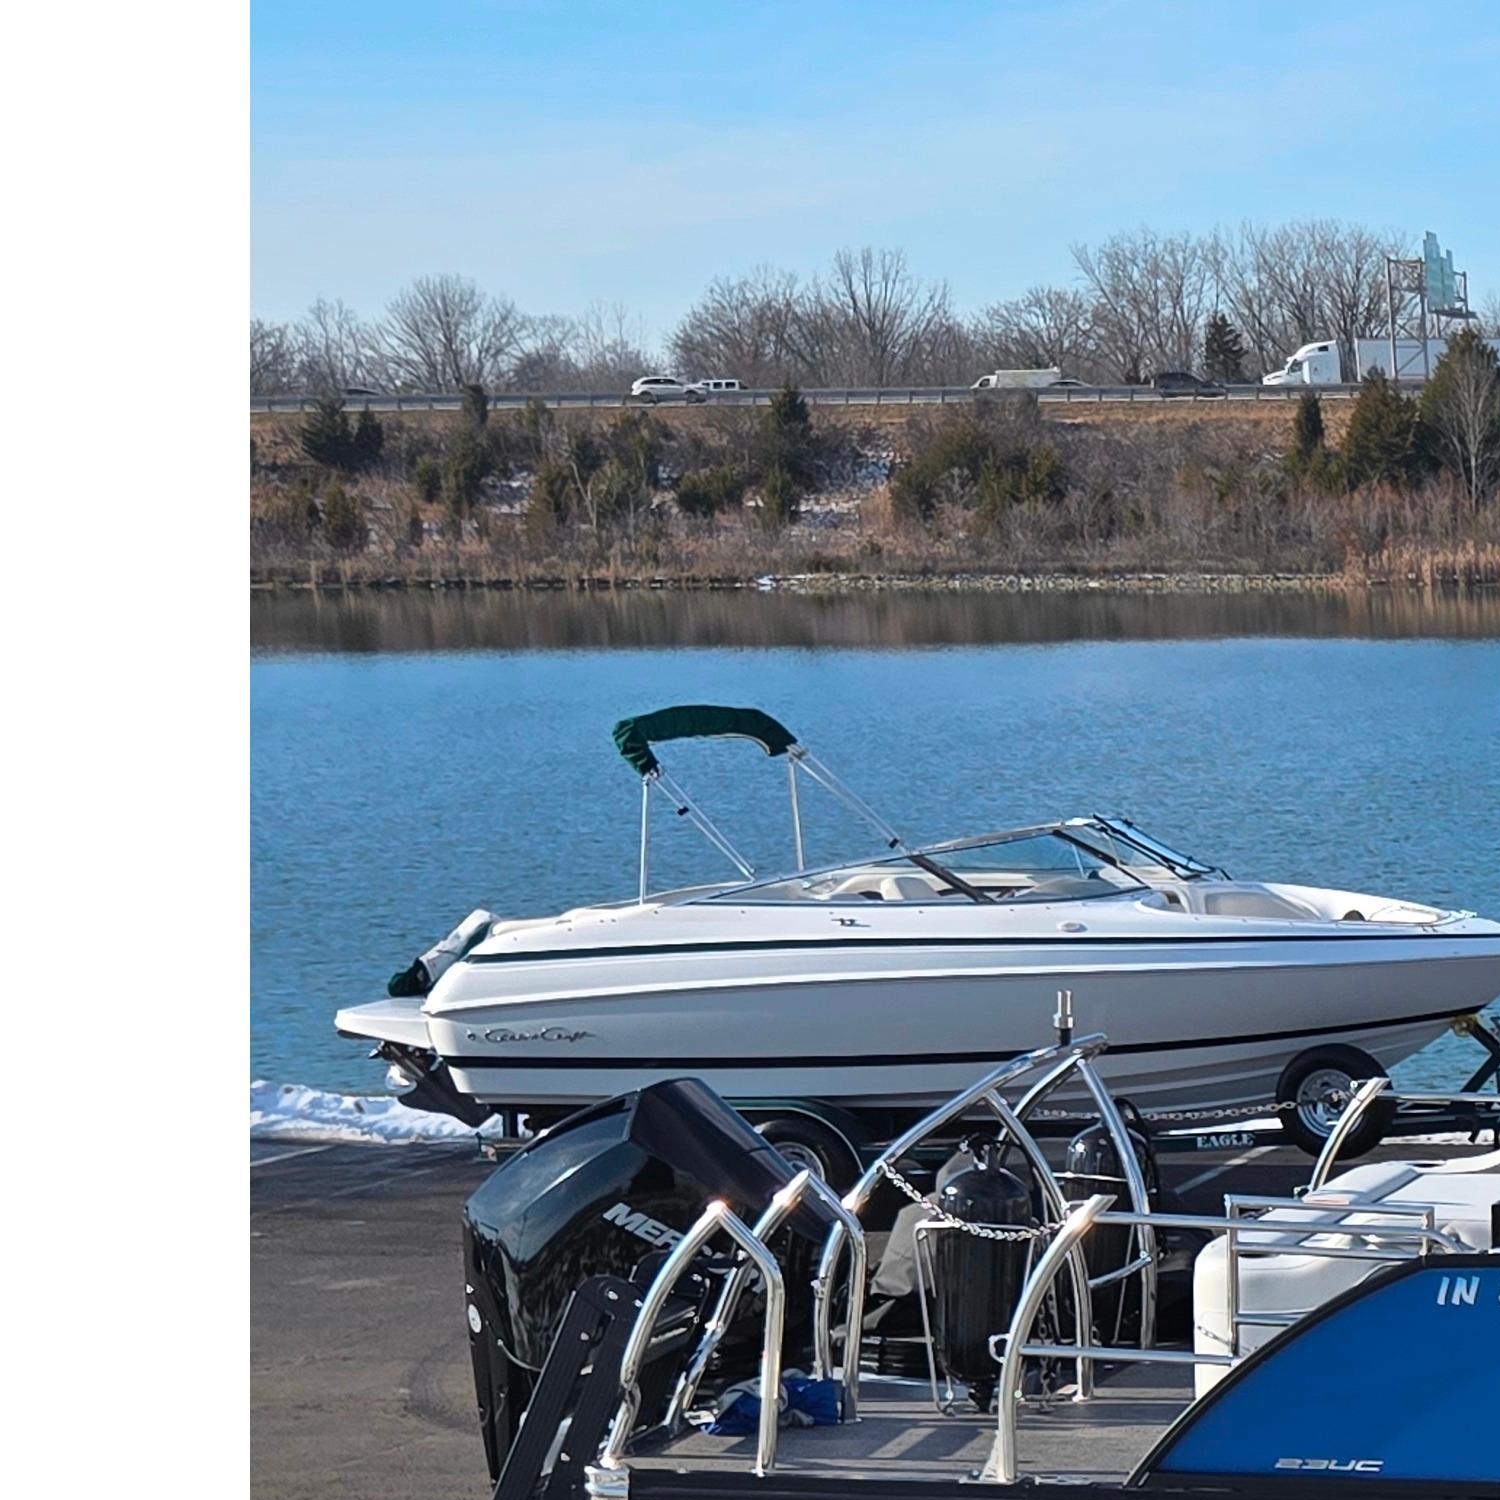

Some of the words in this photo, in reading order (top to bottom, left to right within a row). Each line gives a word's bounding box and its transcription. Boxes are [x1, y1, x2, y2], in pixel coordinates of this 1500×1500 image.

[1197, 1134, 1255, 1148] EAGLE
[1436, 1275, 1480, 1306] IN
[1274, 1457, 1385, 1473] 23UC
